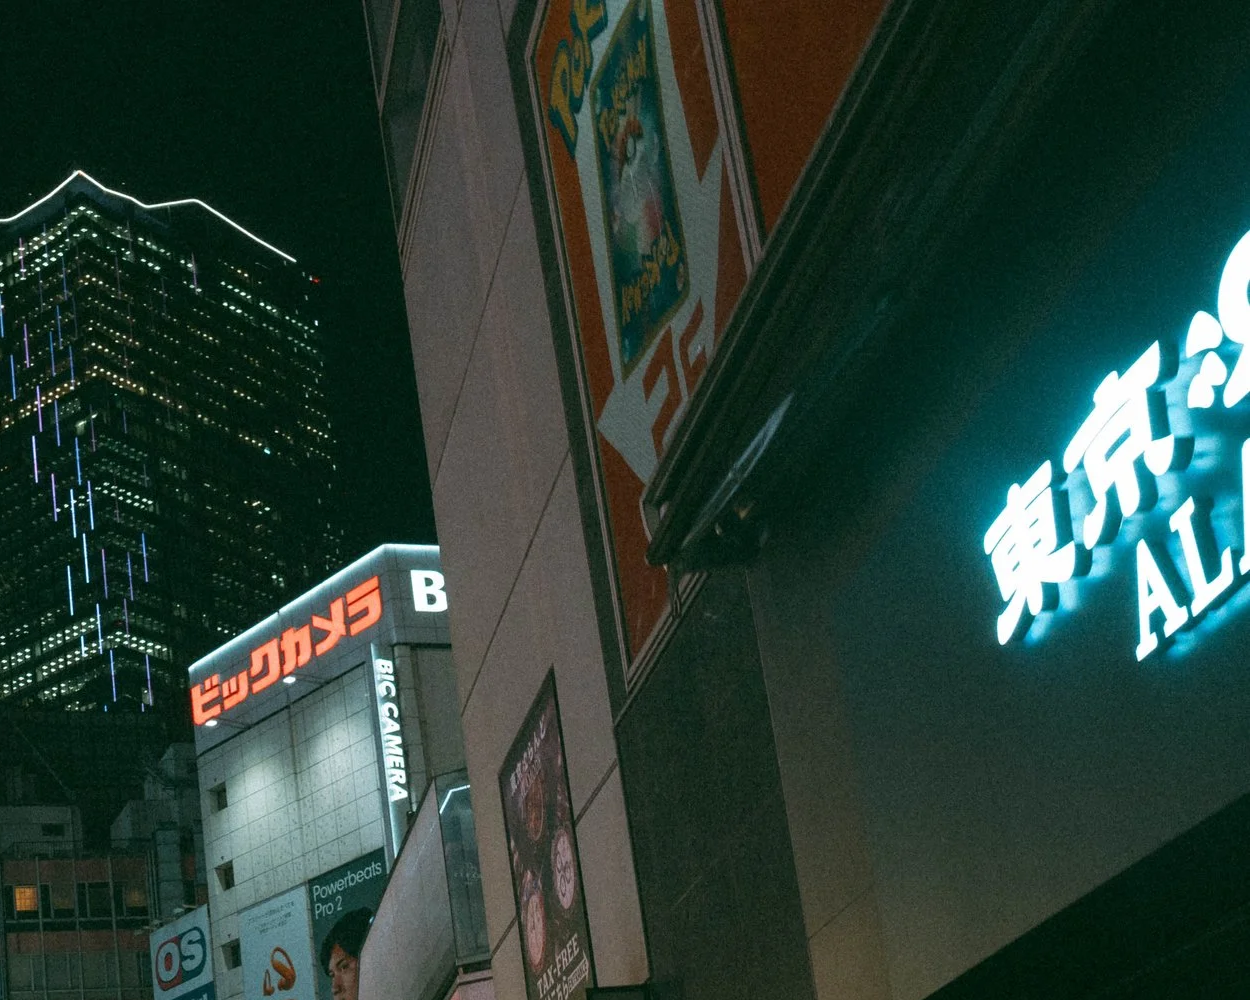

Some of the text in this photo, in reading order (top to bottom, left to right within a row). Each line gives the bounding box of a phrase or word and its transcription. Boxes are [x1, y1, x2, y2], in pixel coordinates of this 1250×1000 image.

[190, 575, 383, 726] ビックカメラ
[374, 657, 409, 802] BIC CAMERA
[311, 861, 383, 902] Powerbeats
[314, 902, 335, 920] Pro
[336, 895, 344, 912] 2
[157, 926, 207, 991] OS
[536, 932, 580, 1000] TAX-FREE
